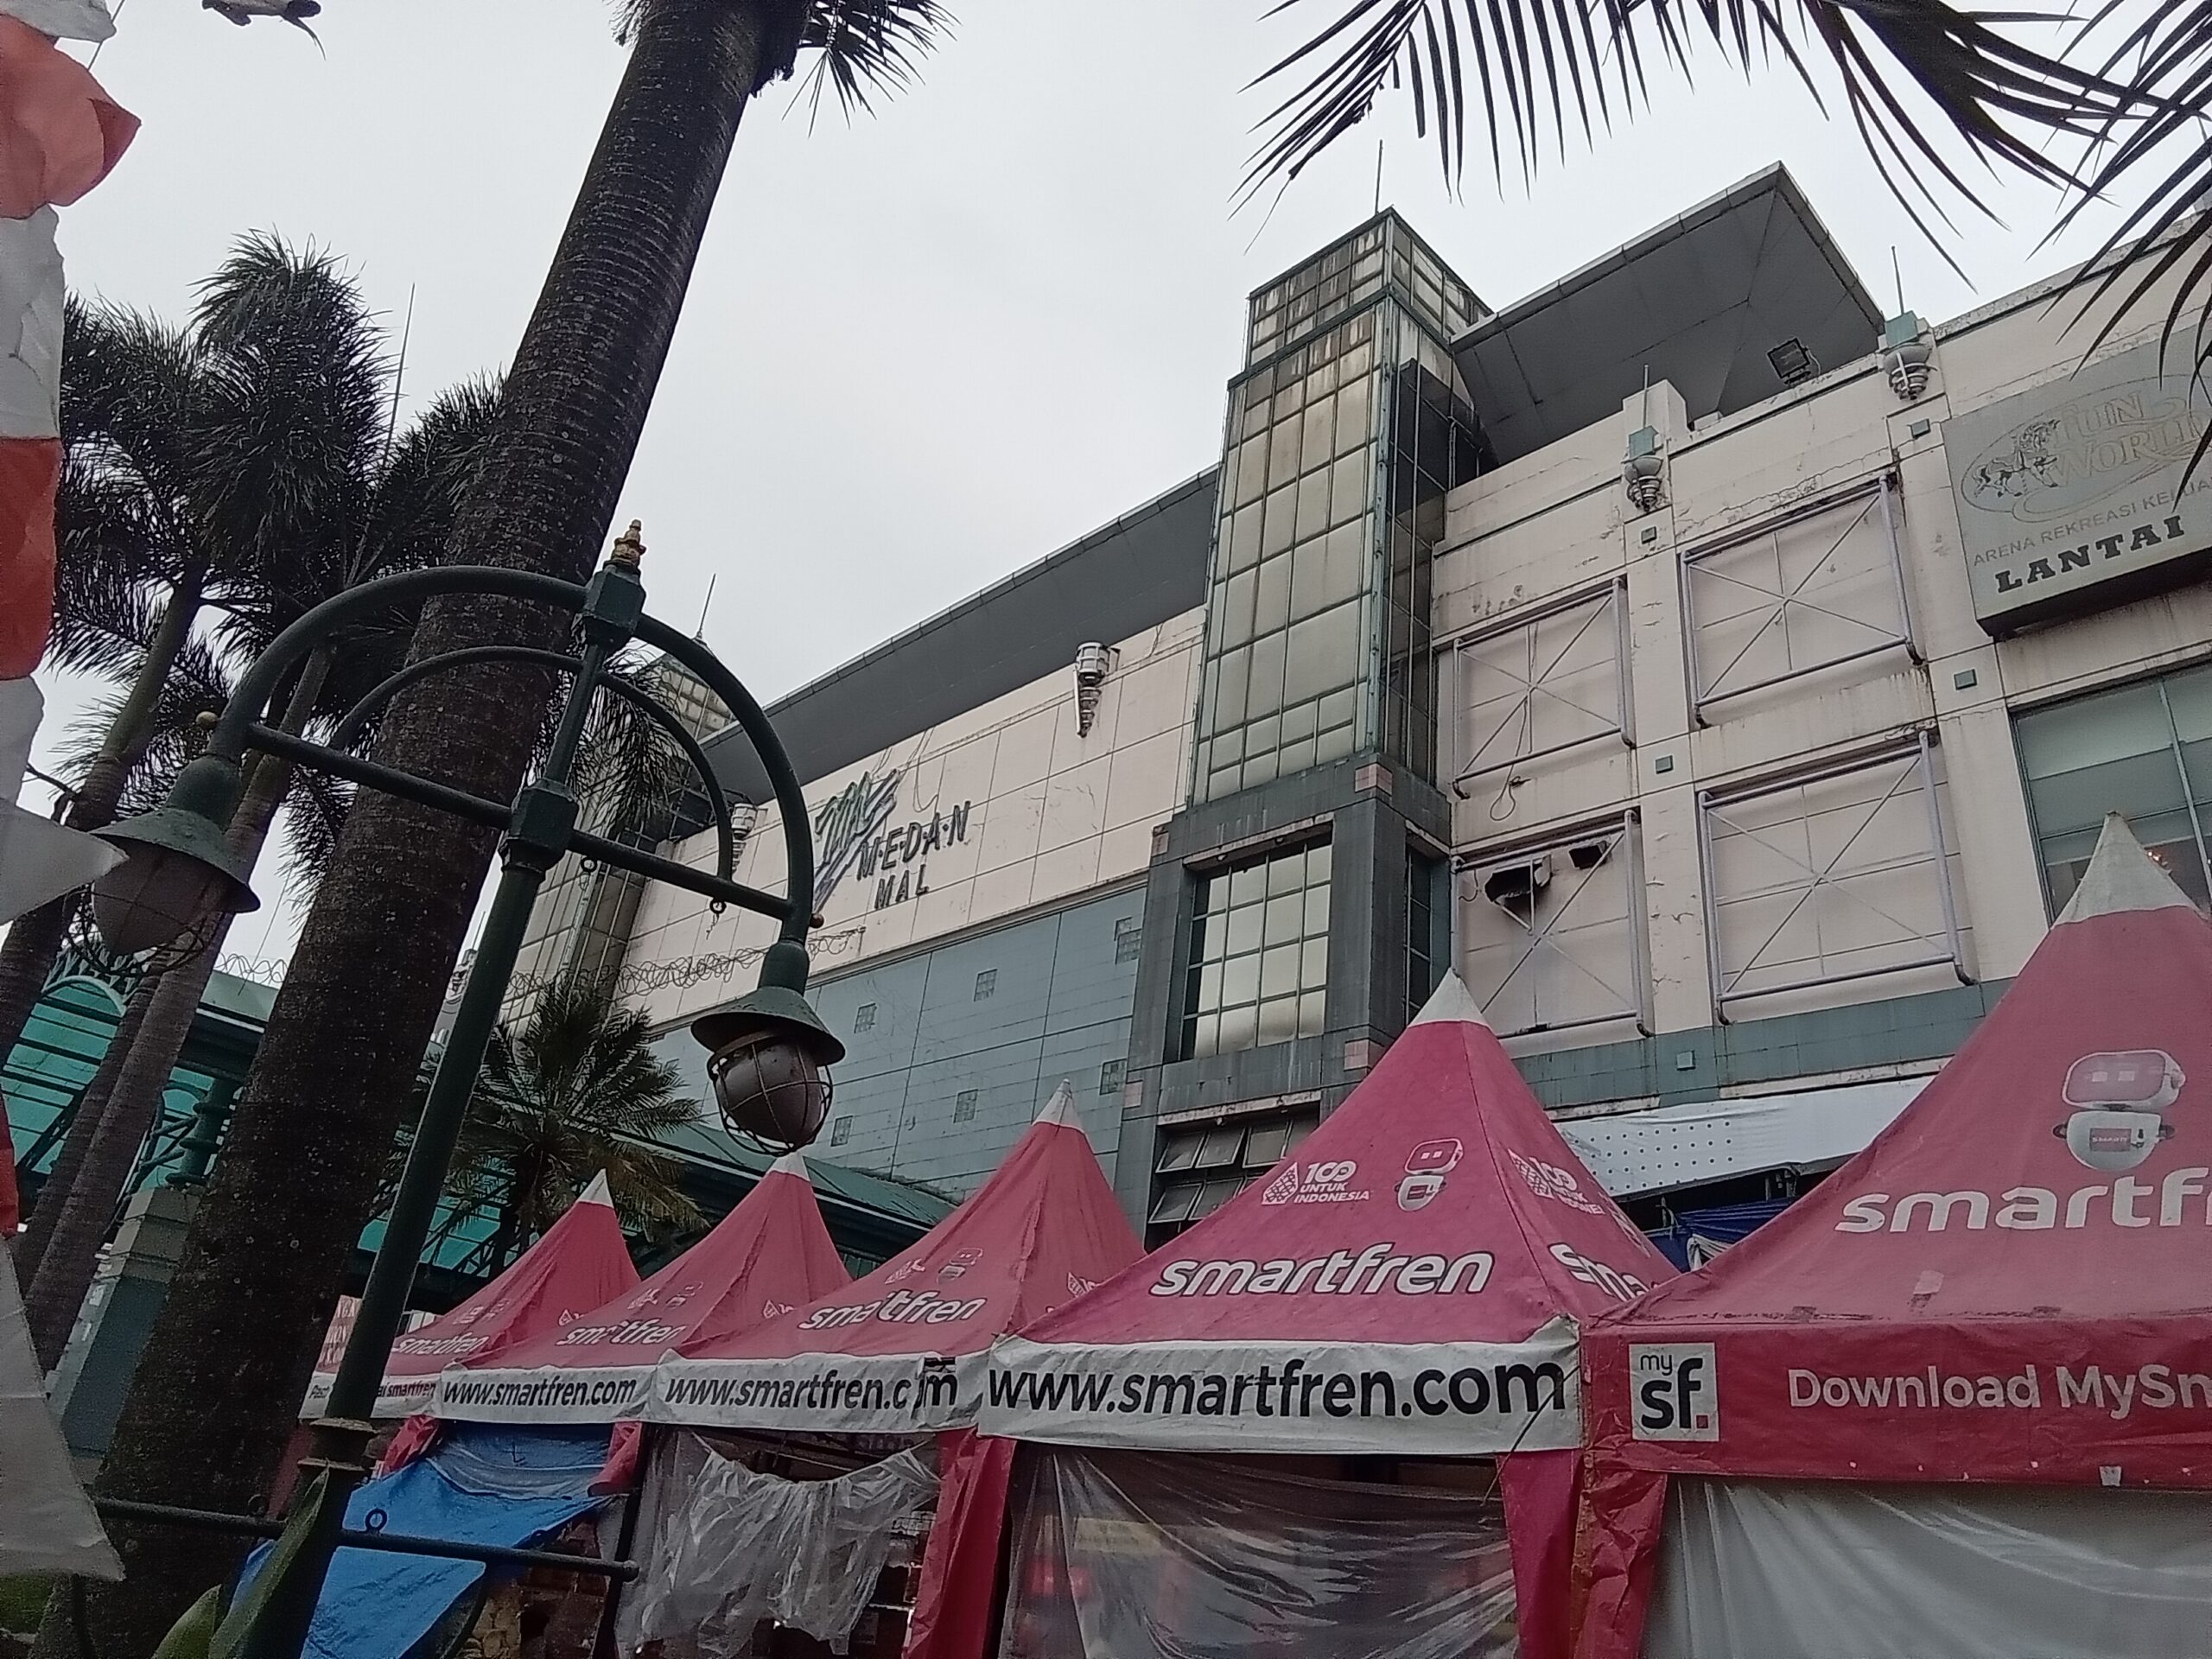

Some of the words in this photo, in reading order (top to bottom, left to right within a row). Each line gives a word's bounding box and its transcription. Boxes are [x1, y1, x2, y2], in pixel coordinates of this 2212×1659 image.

[1974, 533, 2036, 567] ARENA
[2041, 502, 2137, 544] REKREASI
[1994, 514, 2185, 594] LANTAI
[1299, 1180, 1349, 1194] UNTUK
[1304, 1160, 1357, 1184] 100
[1293, 1190, 1370, 1204] INDONESIA
[1835, 1166, 2212, 1233] smartf
[1150, 1242, 1495, 1297] smartfren
[1640, 1352, 1674, 1376] my
[442, 1375, 637, 1408] www.smartfren.com
[664, 1368, 958, 1412] www.smartfren.cm
[988, 1357, 1567, 1418] www.smartfren.com
[1787, 1364, 2041, 1409] Download
